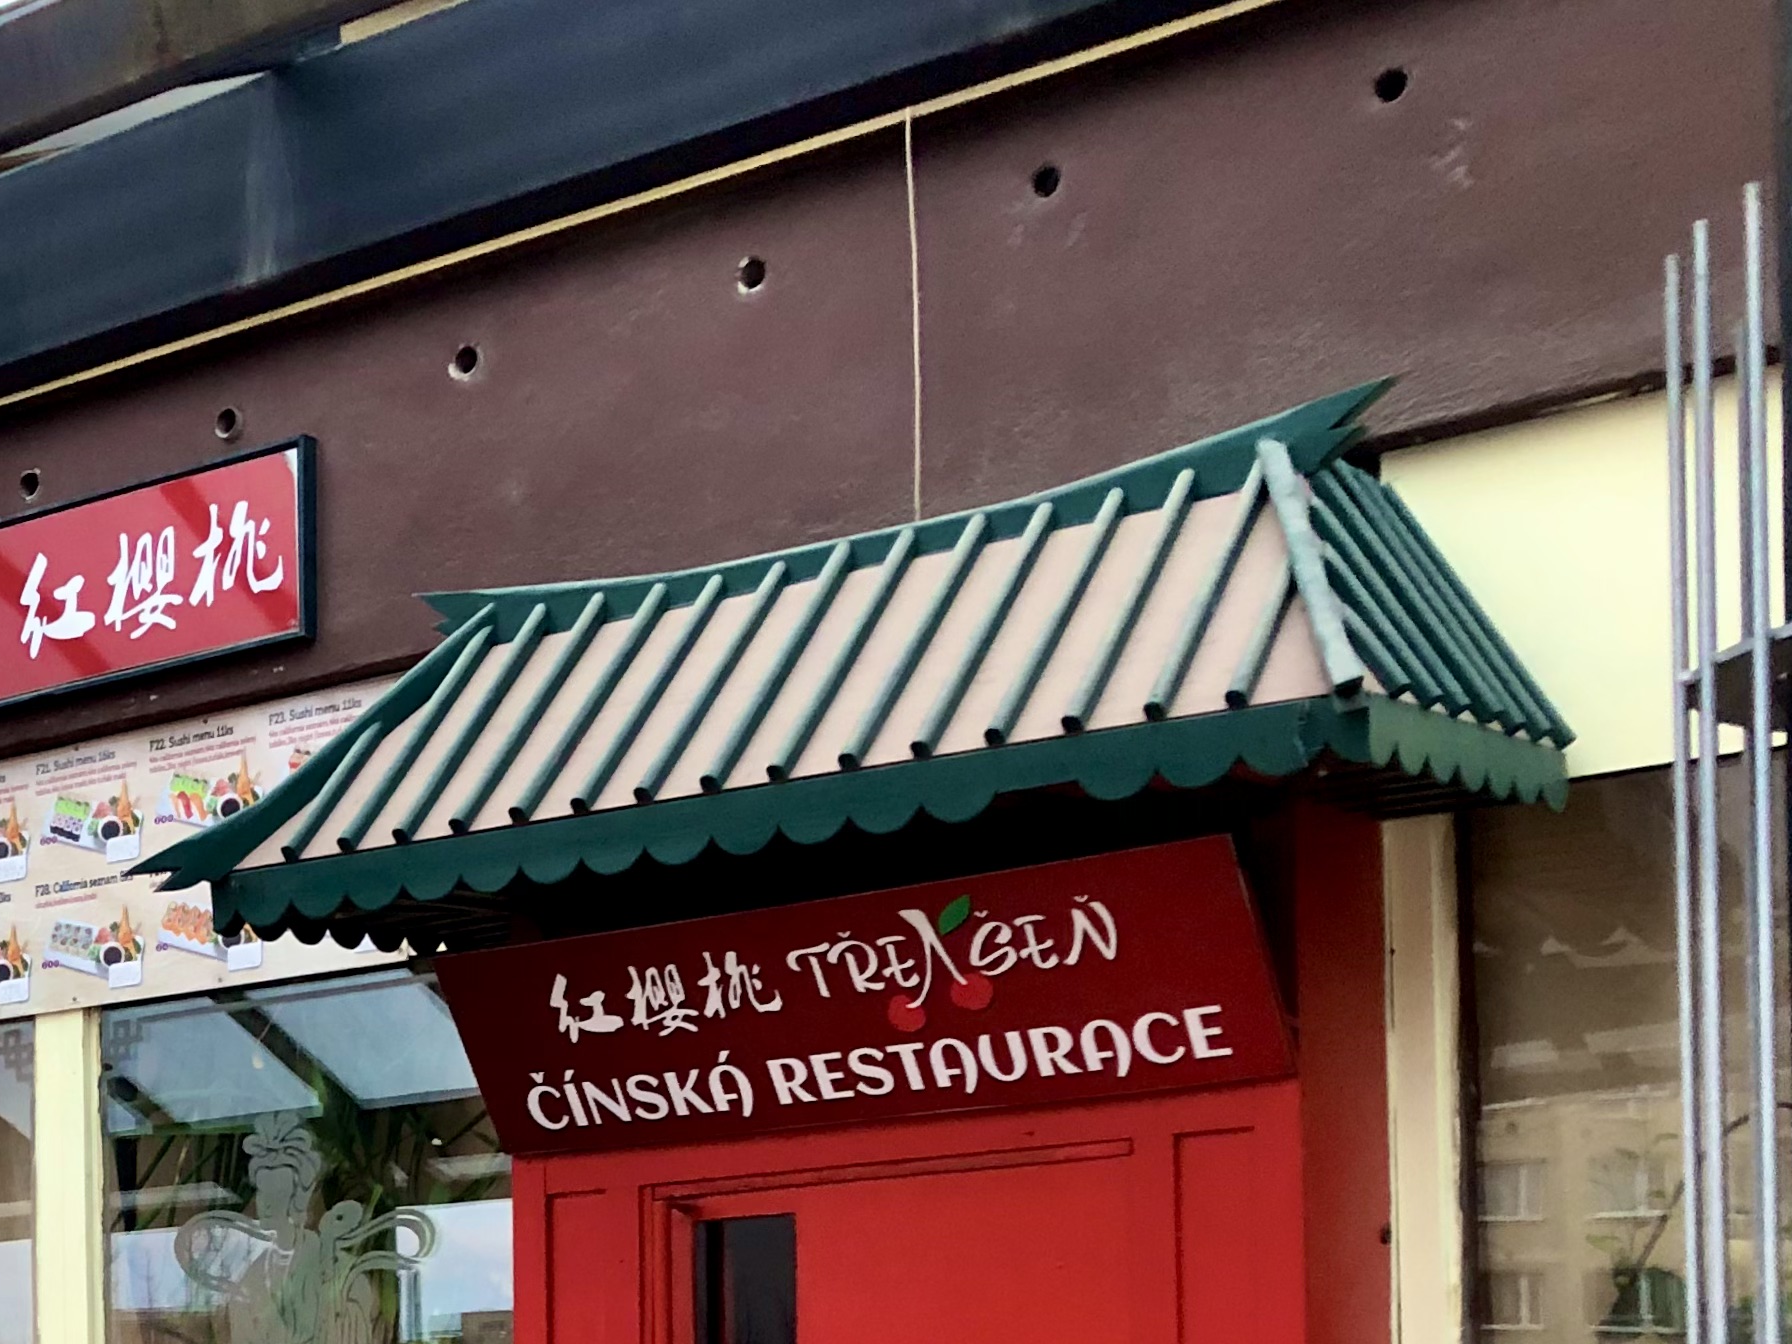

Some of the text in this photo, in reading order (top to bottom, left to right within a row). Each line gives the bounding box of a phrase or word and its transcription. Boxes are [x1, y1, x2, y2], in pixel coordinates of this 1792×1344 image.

[289, 705, 313, 722] Sushi
[315, 702, 339, 716] menu
[168, 732, 190, 747] Sushi
[192, 729, 214, 742] menu
[53, 756, 73, 771] Sushi
[75, 753, 96, 767] menu
[53, 876, 87, 893] California
[527, 1004, 1234, 1130] ČÍNSKÁ RESTAURACE
